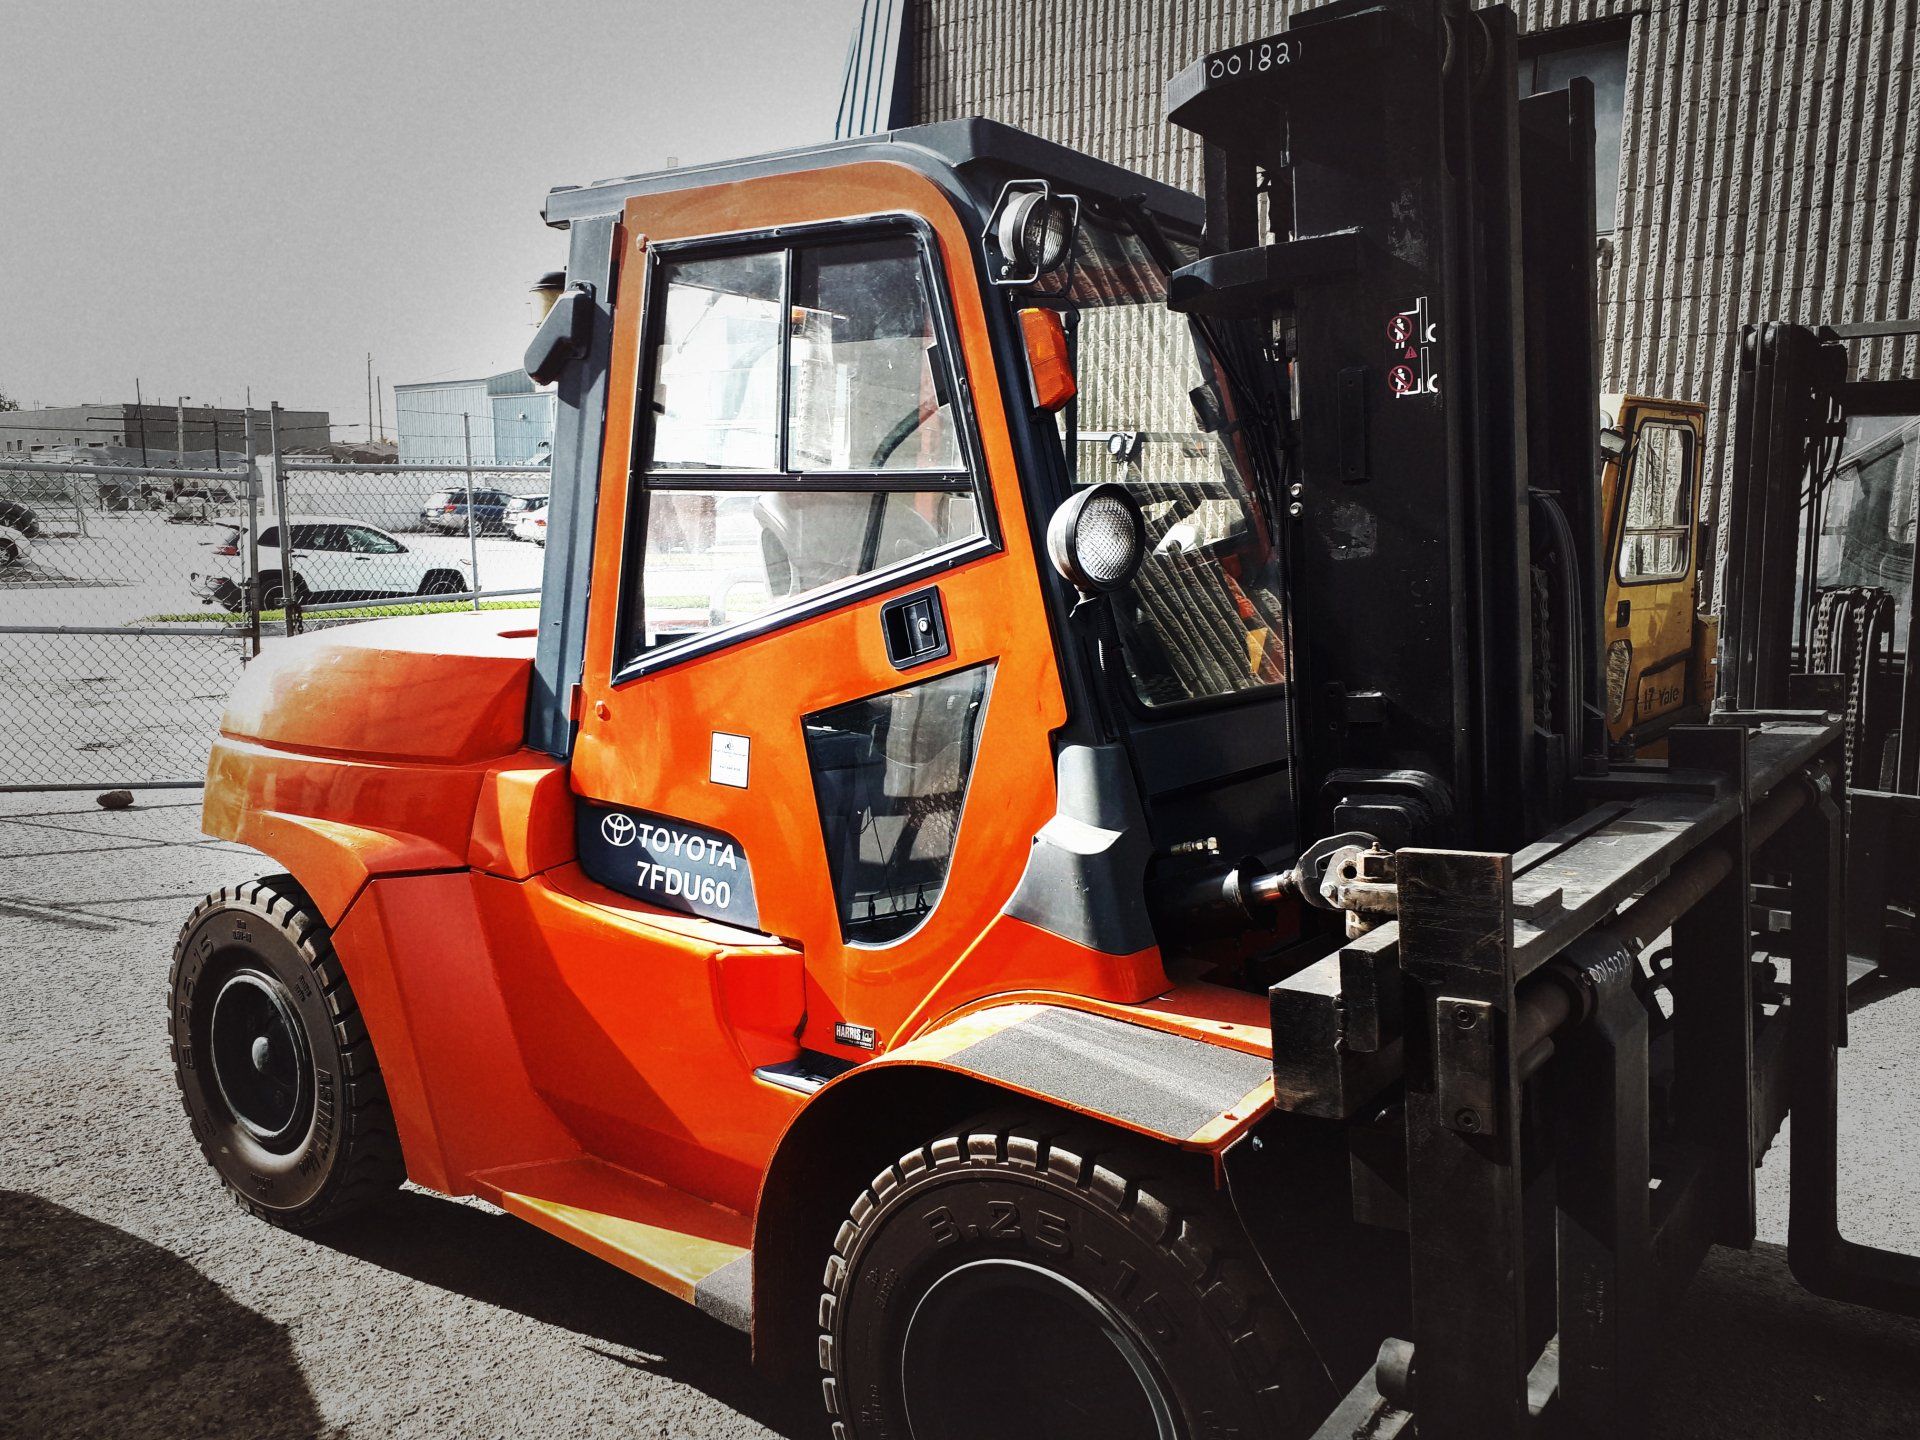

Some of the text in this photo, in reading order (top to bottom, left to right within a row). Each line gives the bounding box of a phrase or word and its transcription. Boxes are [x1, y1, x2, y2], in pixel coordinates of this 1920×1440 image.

[1658, 687, 1680, 706] Yale
[638, 823, 737, 870] TOYOTA
[636, 861, 731, 909] 7FDU60
